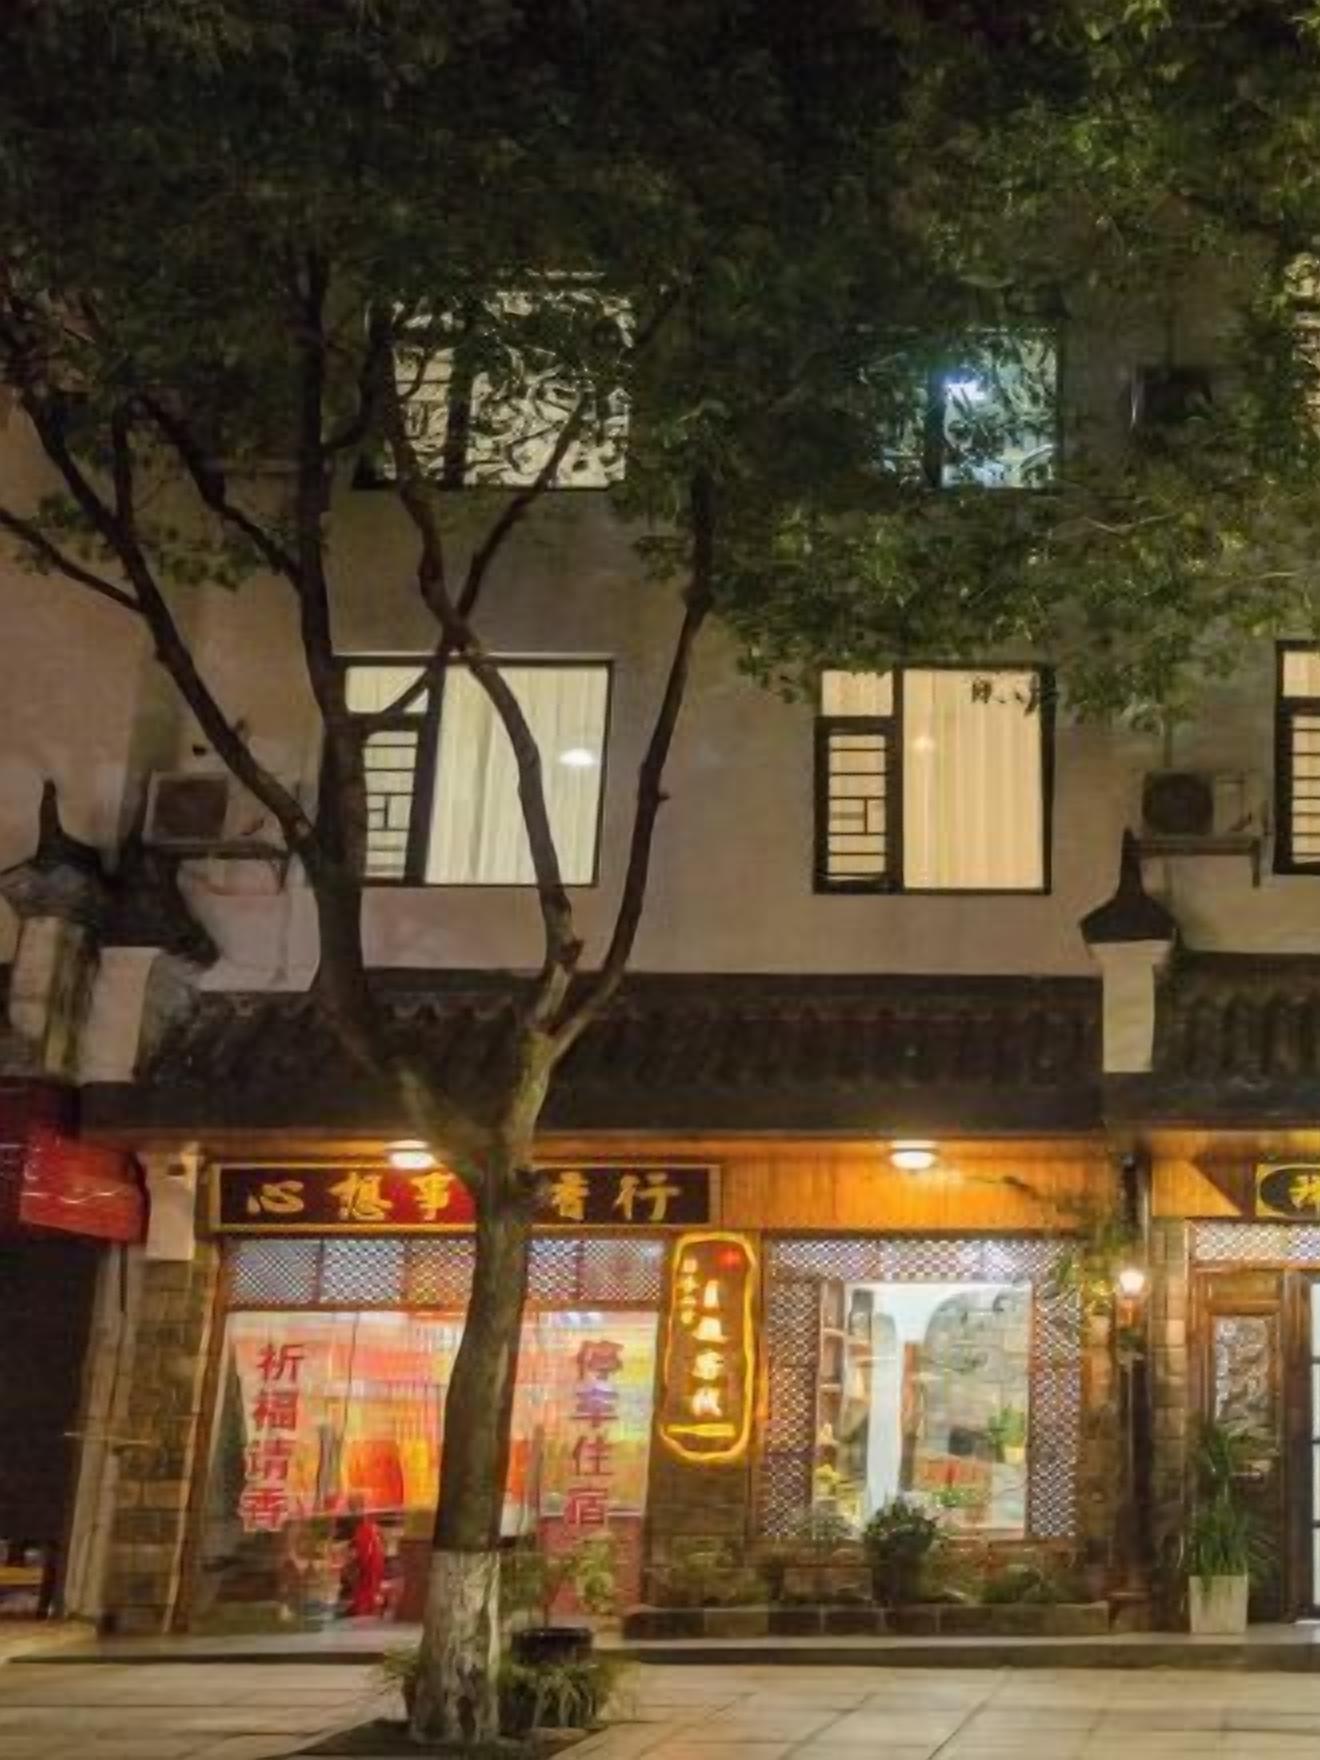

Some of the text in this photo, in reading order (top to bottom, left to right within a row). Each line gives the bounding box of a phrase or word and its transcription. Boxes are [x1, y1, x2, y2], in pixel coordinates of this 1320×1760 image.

[247, 1171, 681, 1221] 心想事香行
[240, 1343, 304, 1529] 祈福请香
[564, 1340, 625, 1525] 停车住宿
